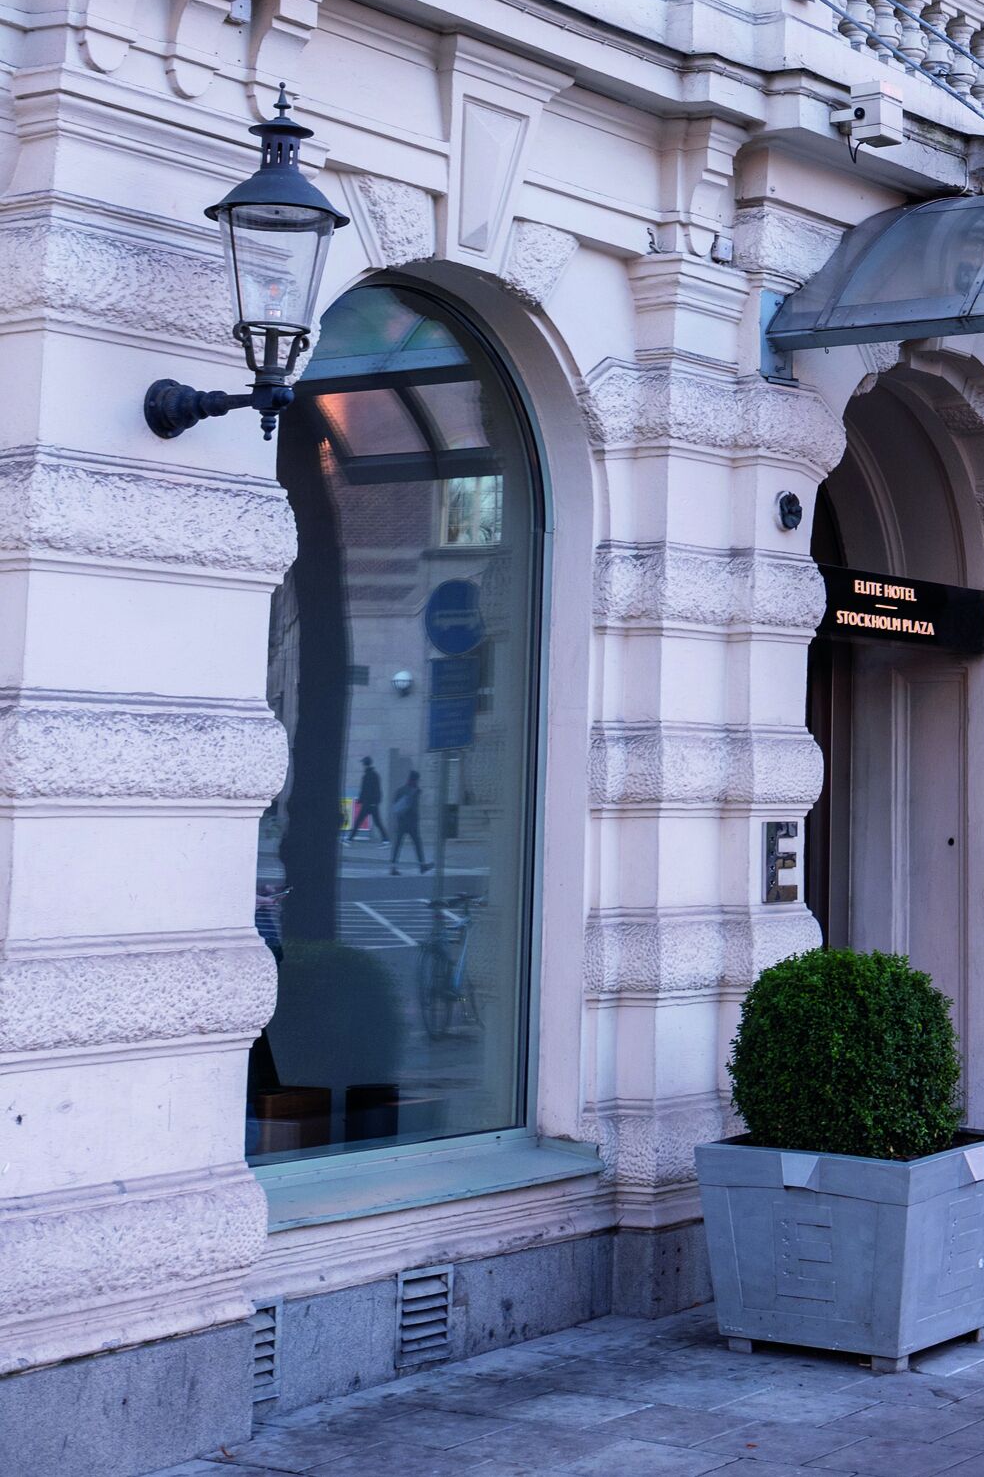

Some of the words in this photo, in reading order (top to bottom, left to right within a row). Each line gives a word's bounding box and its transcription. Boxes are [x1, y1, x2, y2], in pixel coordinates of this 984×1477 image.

[854, 579, 883, 597] ELITE
[884, 584, 917, 602] HOTEL
[836, 610, 901, 632] STOCKHOLM
[902, 619, 935, 636] PLAZA
[765, 822, 798, 903] E
